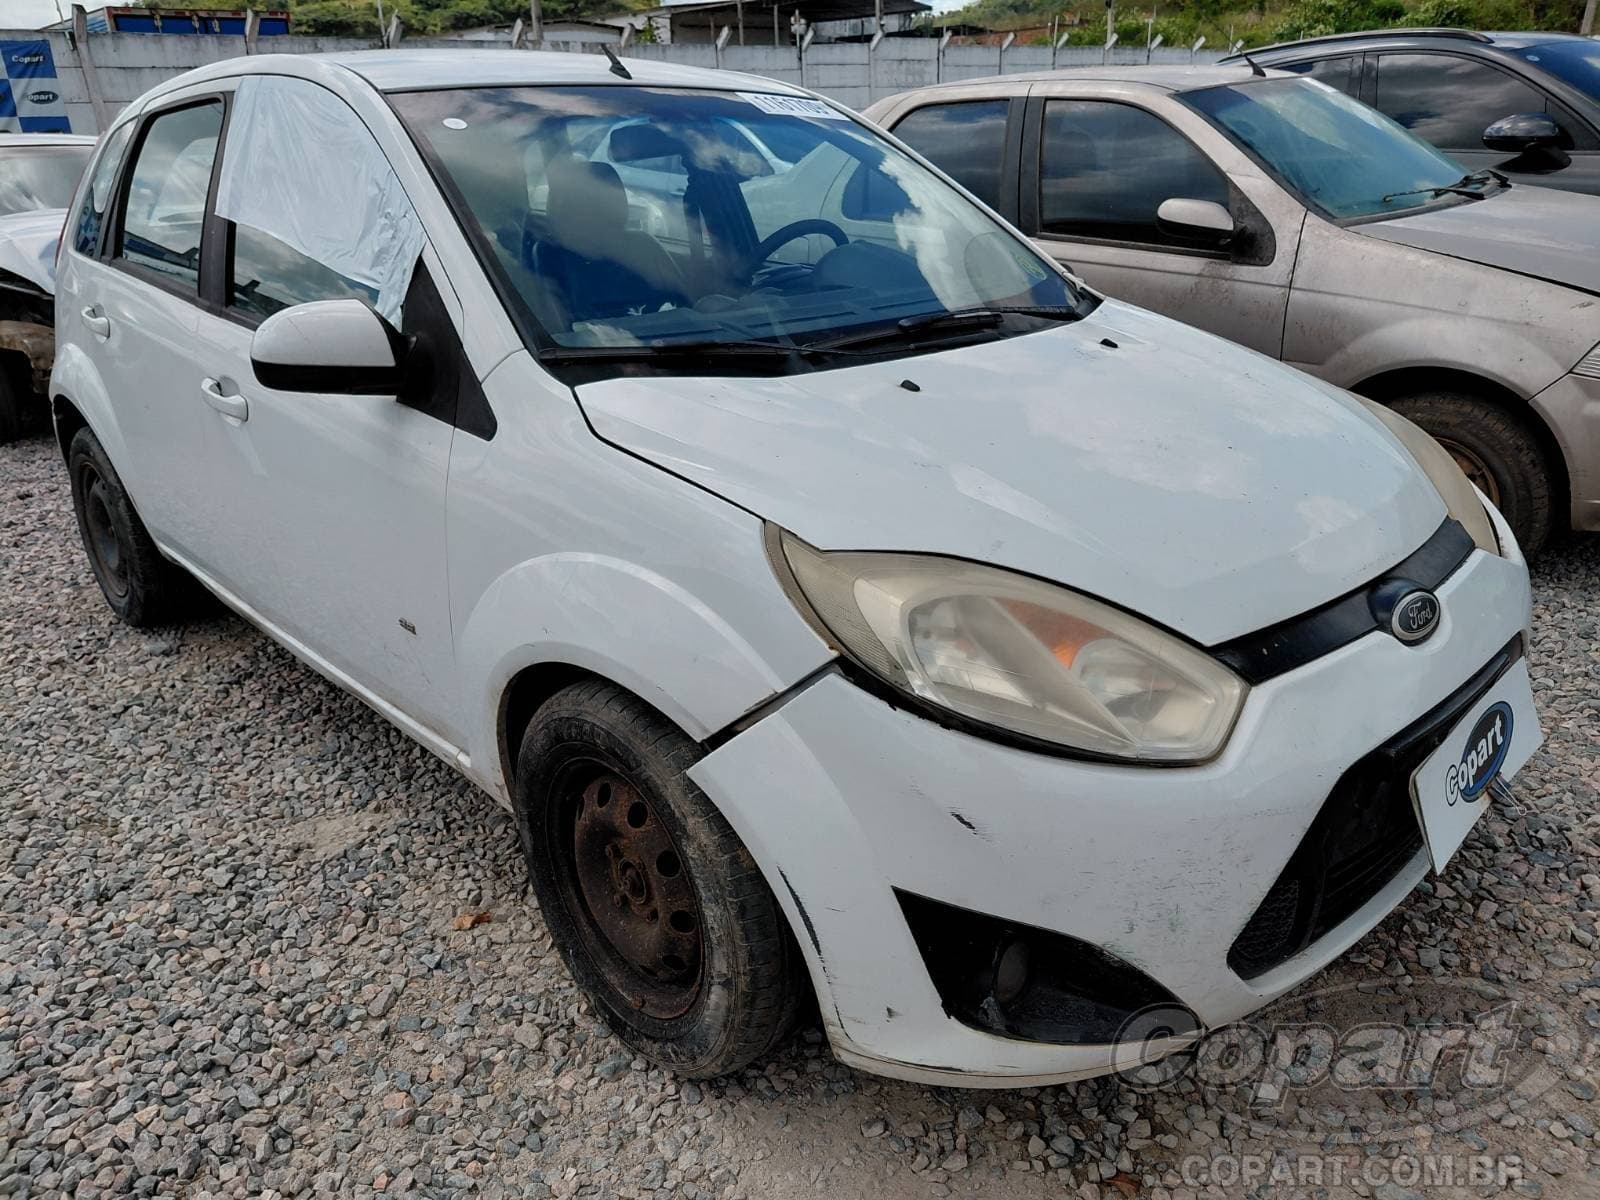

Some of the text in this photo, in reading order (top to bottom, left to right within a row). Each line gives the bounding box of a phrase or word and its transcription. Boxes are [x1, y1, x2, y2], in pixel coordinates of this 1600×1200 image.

[12, 55, 44, 63] Copart
[1407, 601, 1433, 629] Ford
[1446, 714, 1503, 806] Copart
